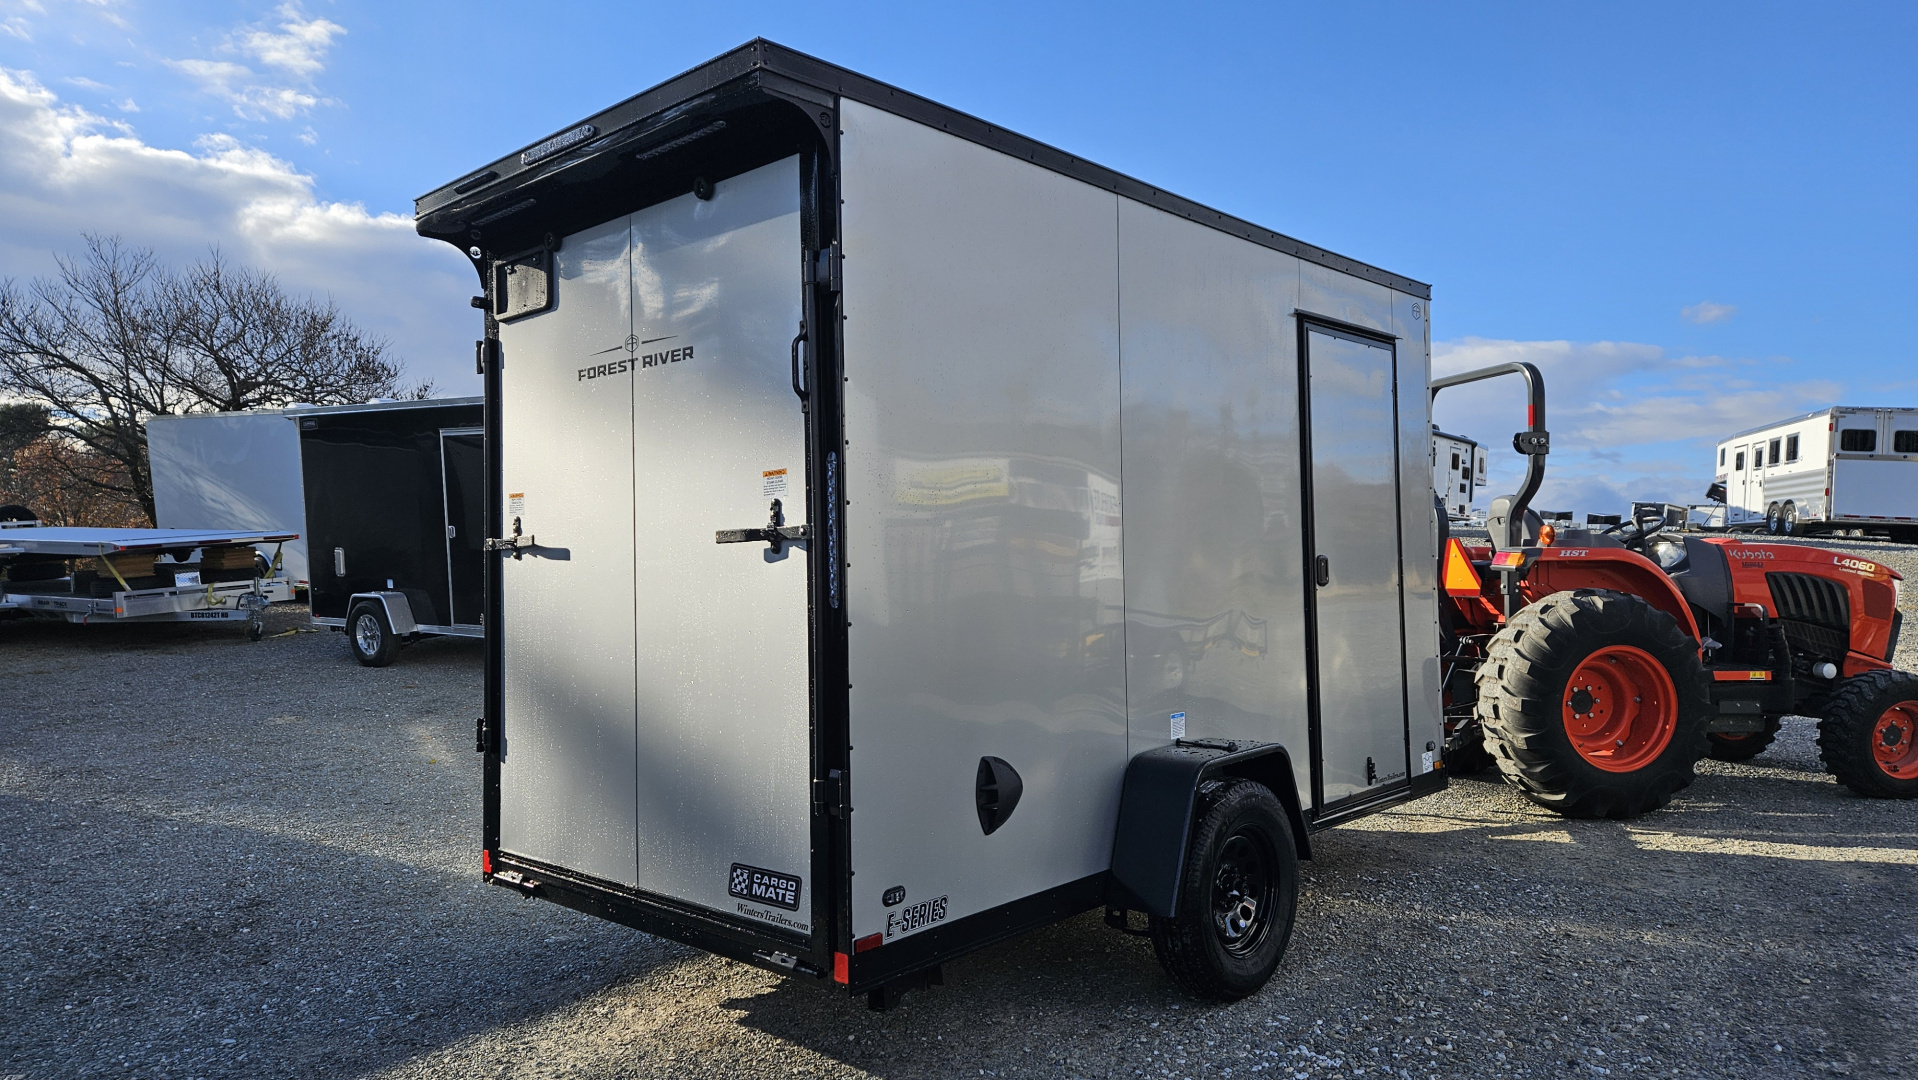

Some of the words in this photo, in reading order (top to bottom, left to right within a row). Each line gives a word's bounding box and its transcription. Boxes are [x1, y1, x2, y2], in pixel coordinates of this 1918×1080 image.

[577, 357, 639, 382] FOREST
[641, 345, 694, 369] RIVER
[1559, 549, 1589, 557] HST
[1728, 549, 1775, 560] Kubota
[1833, 556, 1876, 572] L4060
[753, 873, 796, 891] CARGO
[752, 883, 796, 904] MATE
[736, 902, 809, 932] WintersTrailers.com
[885, 895, 948, 940] E-SERIES
